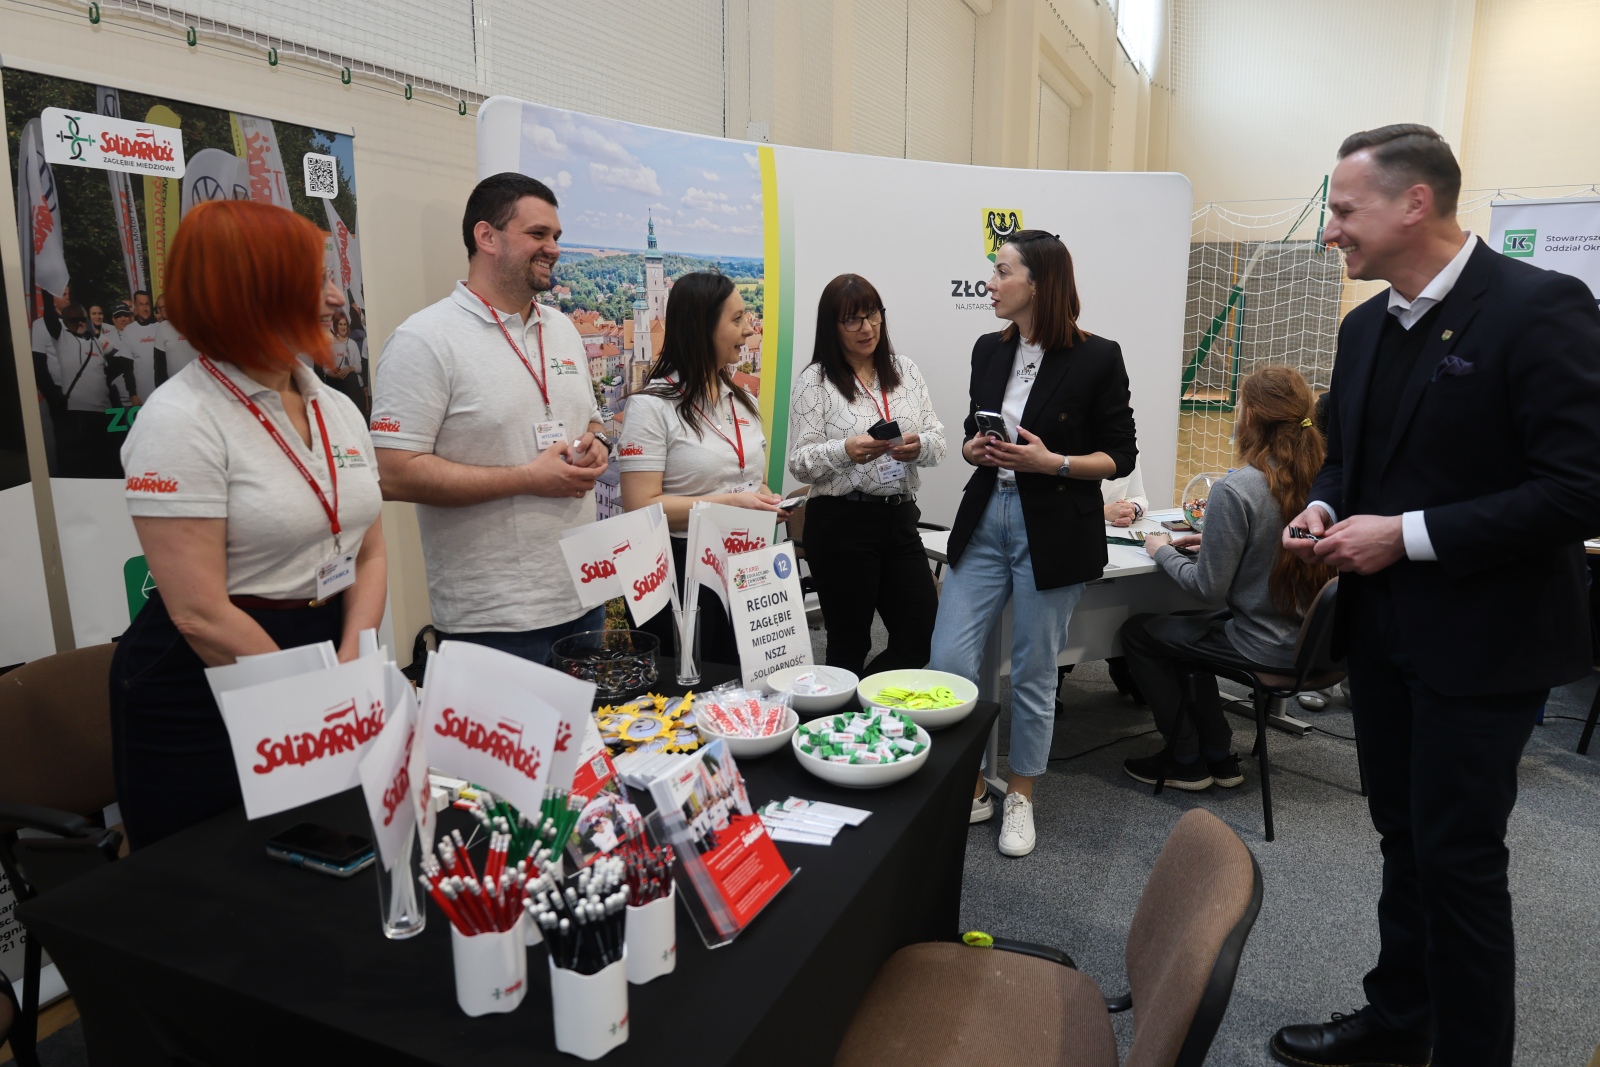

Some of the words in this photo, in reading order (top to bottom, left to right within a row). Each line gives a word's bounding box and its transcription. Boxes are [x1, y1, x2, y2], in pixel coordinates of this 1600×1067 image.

[103, 156, 135, 168] ZAGŁĘBIE
[136, 161, 176, 173] MIEDZIOWE
[1545, 244, 1580, 252] Oddział
[951, 280, 989, 297] ZŁO
[955, 303, 995, 311] NAJSTARSZ
[778, 560, 788, 573] 12
[747, 590, 788, 612] REGION
[750, 610, 792, 632] ZAGŁĘBIE
[752, 626, 796, 648] MIEDZIOWE
[765, 645, 787, 661] NSZZ
